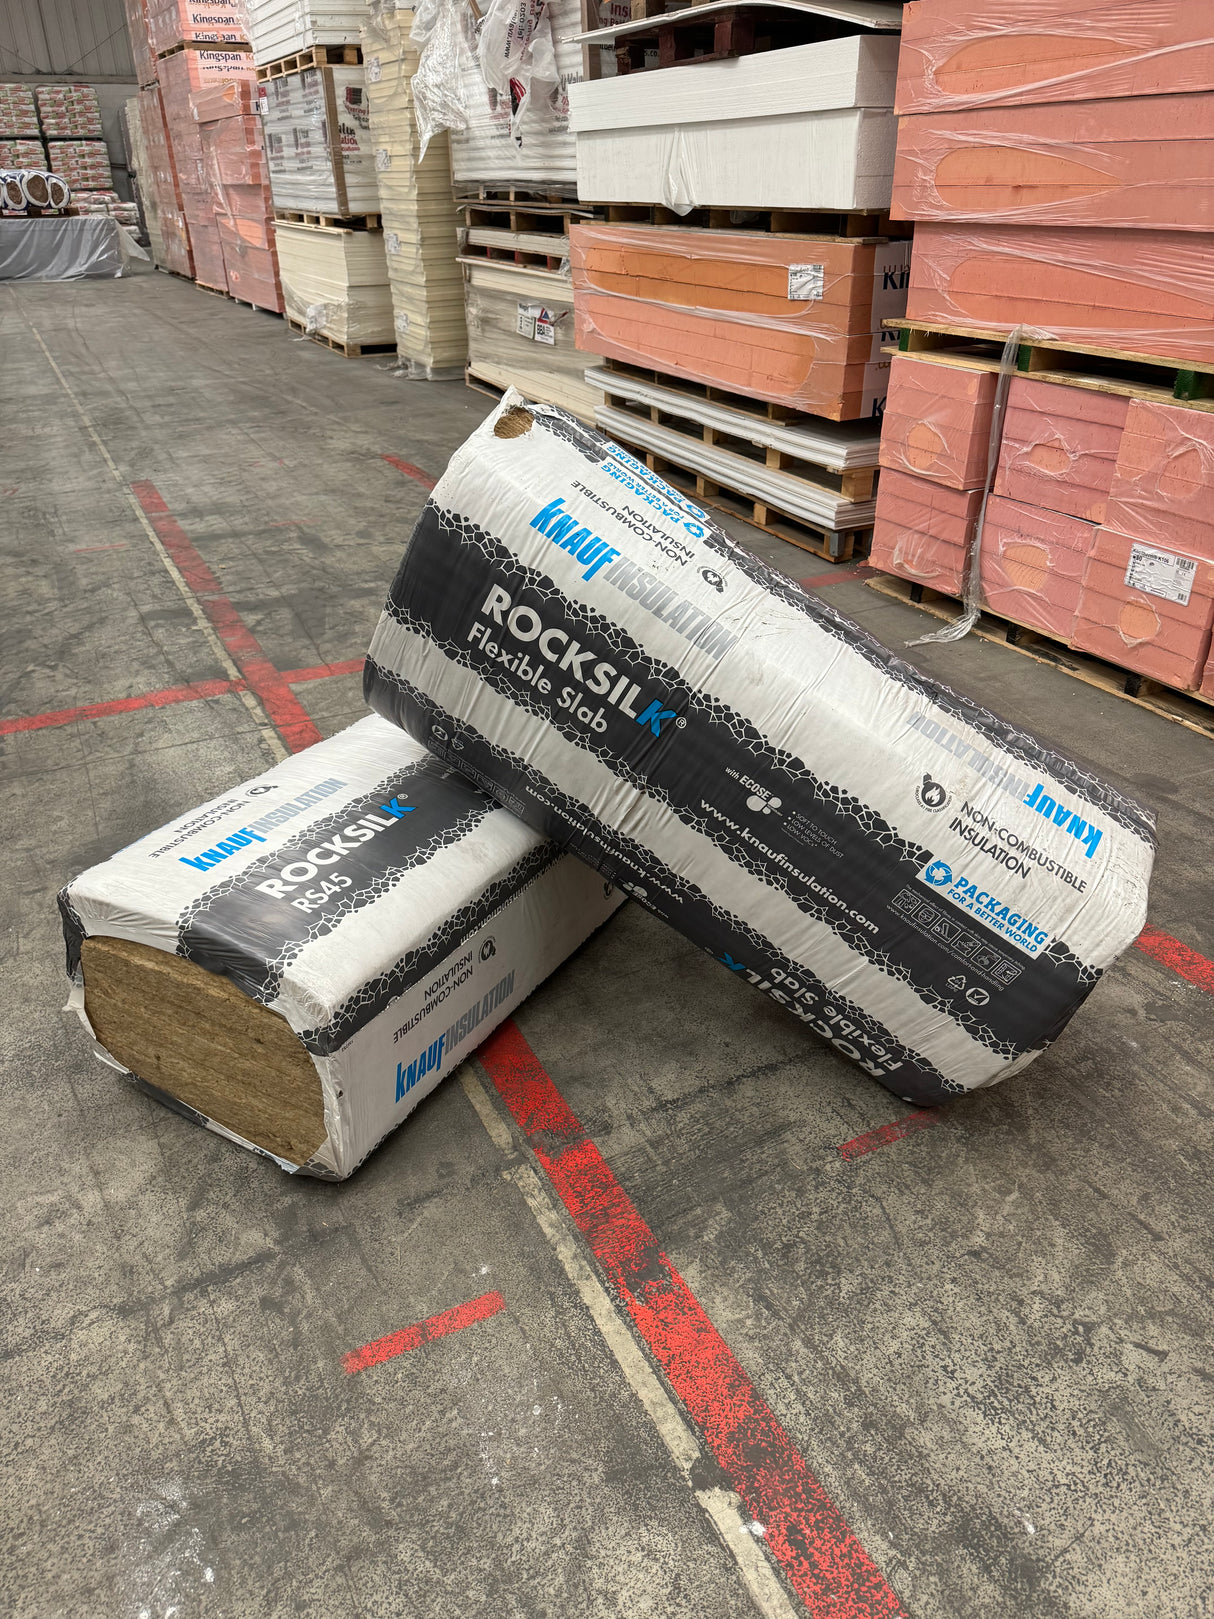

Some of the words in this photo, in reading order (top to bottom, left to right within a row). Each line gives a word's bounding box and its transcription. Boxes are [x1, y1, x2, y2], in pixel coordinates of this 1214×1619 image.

[200, 50, 242, 62] Kingspan
[571, 480, 688, 566] NON-COMBUSTIBLE
[600, 464, 680, 524] PACKAGING
[529, 498, 620, 582] KNAUF
[622, 505, 695, 560] INSULATION
[466, 621, 551, 694] Flexible
[558, 685, 608, 734] Slab
[726, 767, 740, 780] with
[178, 827, 267, 872] KNAUF
[248, 778, 348, 834] INSULATION
[525, 785, 684, 904] www.knaufinsulation.com
[787, 824, 801, 836] LOW
[791, 819, 806, 830] LOW
[804, 829, 822, 843] LEVELS
[829, 846, 844, 858] DUST
[796, 814, 810, 825] SOFT
[818, 829, 837, 845] TOUCH
[949, 817, 1031, 879] INSULATION
[960, 801, 1087, 893] NON-COMBUSTIBLE
[1023, 783, 1103, 859] KNAUF
[291, 872, 352, 914] RS45
[701, 799, 880, 934] www.knaufinsulation.com
[947, 889, 966, 904] FOR
[974, 905, 1005, 931] BETTER
[1005, 927, 1038, 953] WORLD
[954, 876, 1048, 945] PACKAGING
[393, 965, 474, 1044] NON-COMBUSTIBLE
[424, 950, 473, 1000] INSULATION
[770, 968, 819, 1005] Slab
[395, 1033, 446, 1104] KNAUF
[444, 969, 515, 1056] INSULATION
[823, 1005, 904, 1071] Flexible
